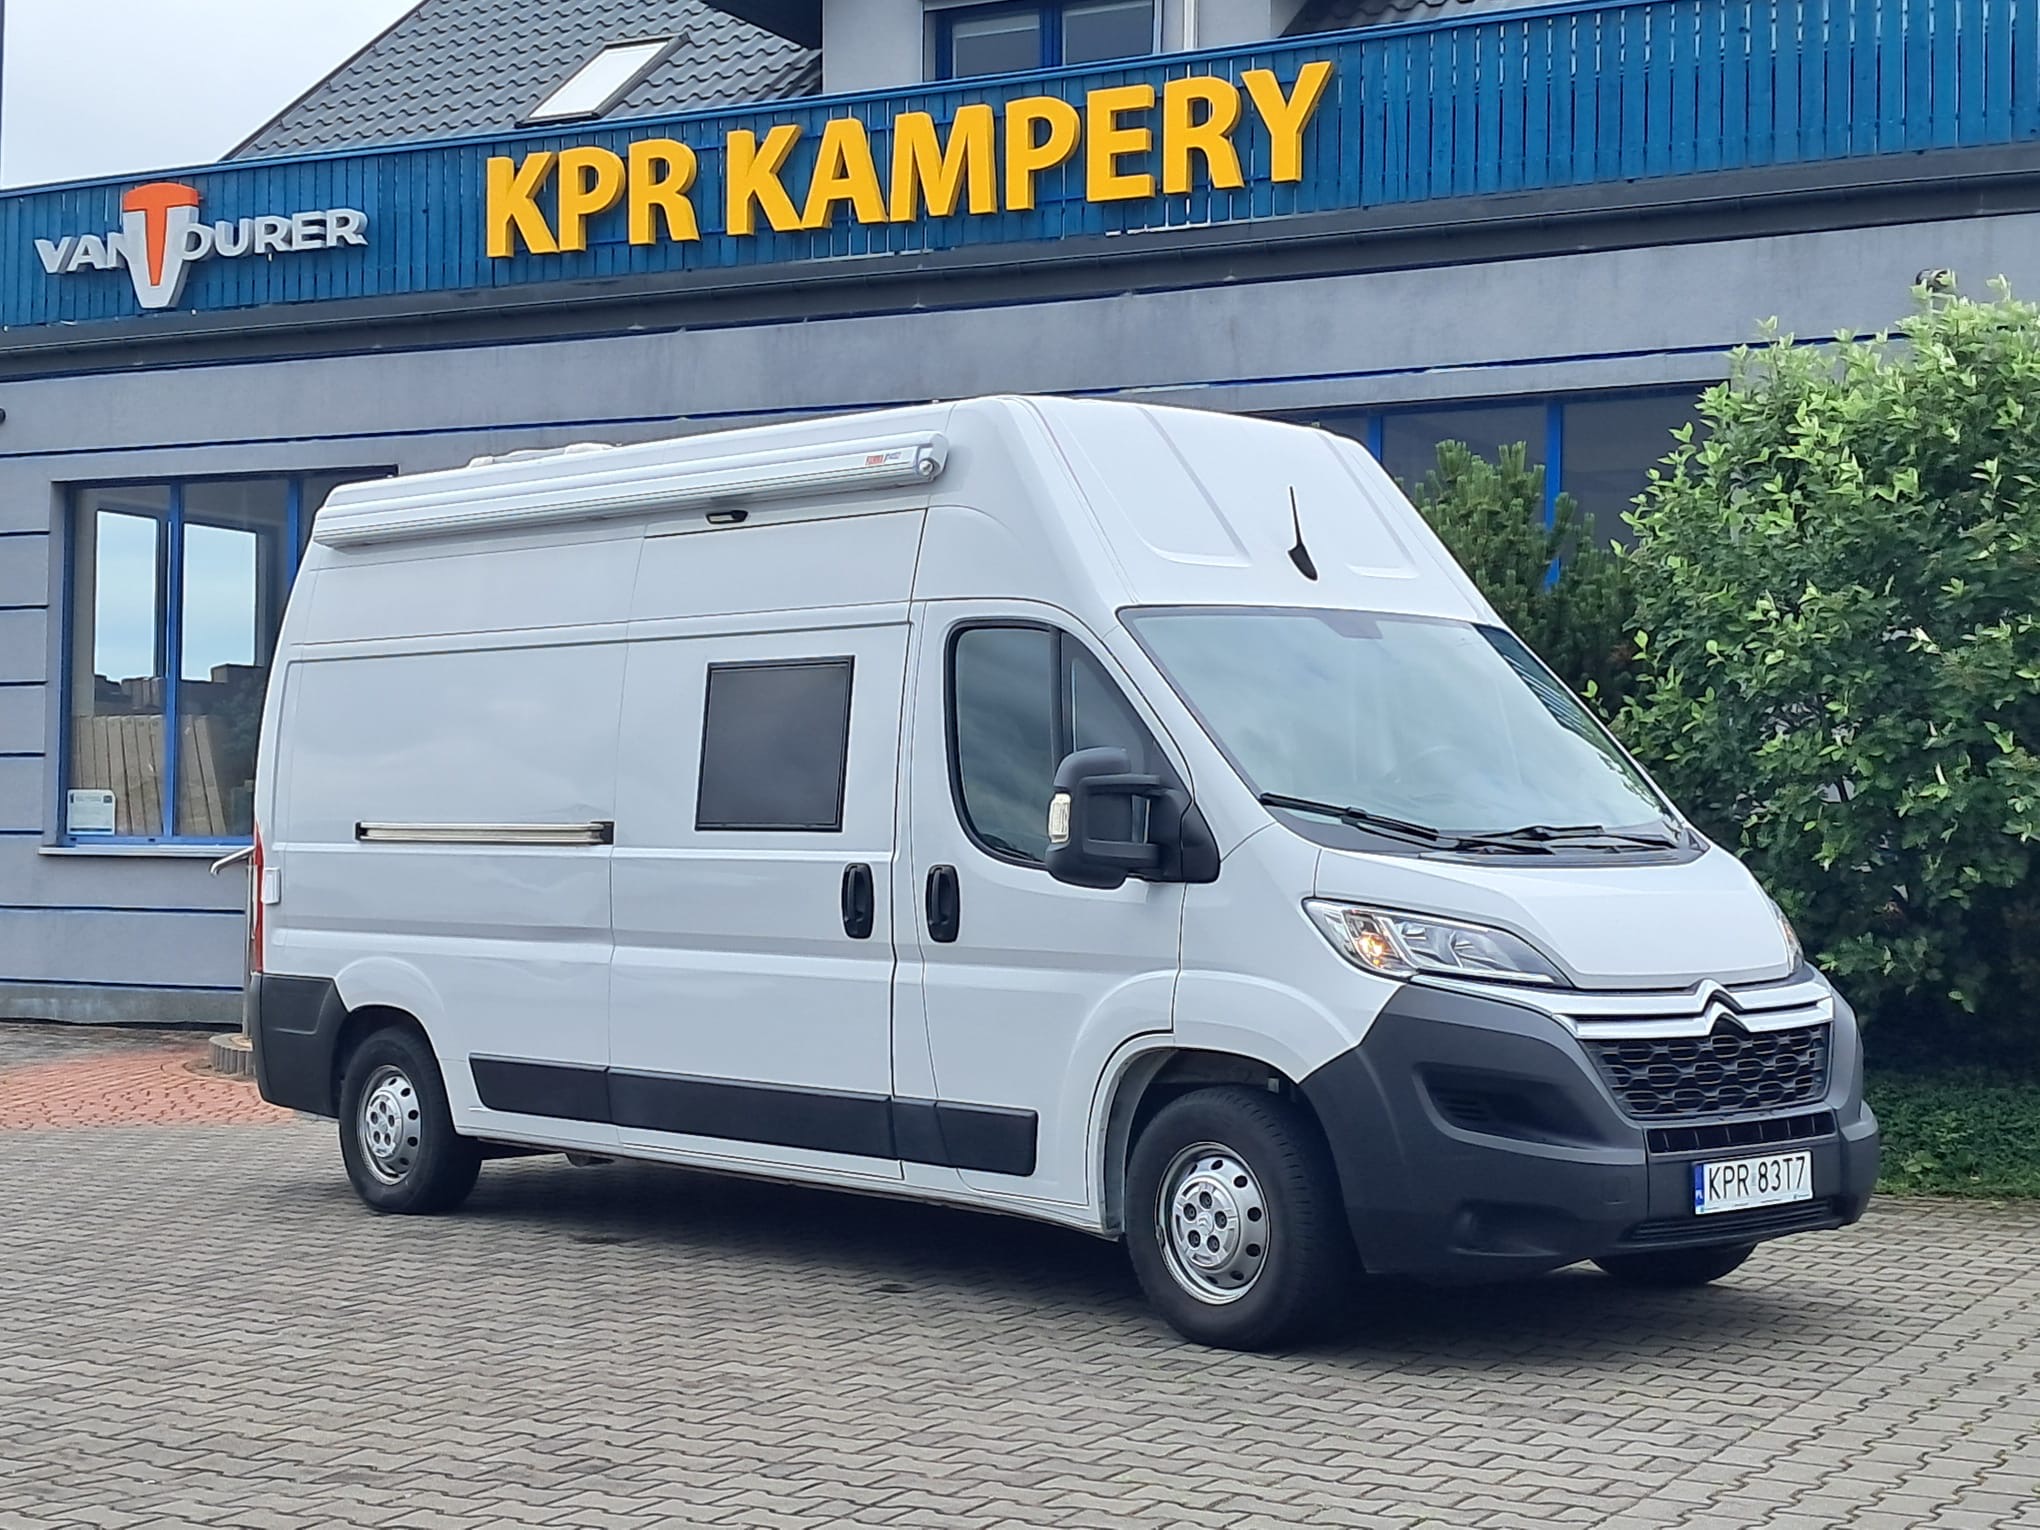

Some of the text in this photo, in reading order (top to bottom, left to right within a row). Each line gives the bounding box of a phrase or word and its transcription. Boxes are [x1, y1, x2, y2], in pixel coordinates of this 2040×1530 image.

[486, 61, 1334, 258] KPR KAMPERY
[1709, 1156, 1805, 1200] KPR 83T7
